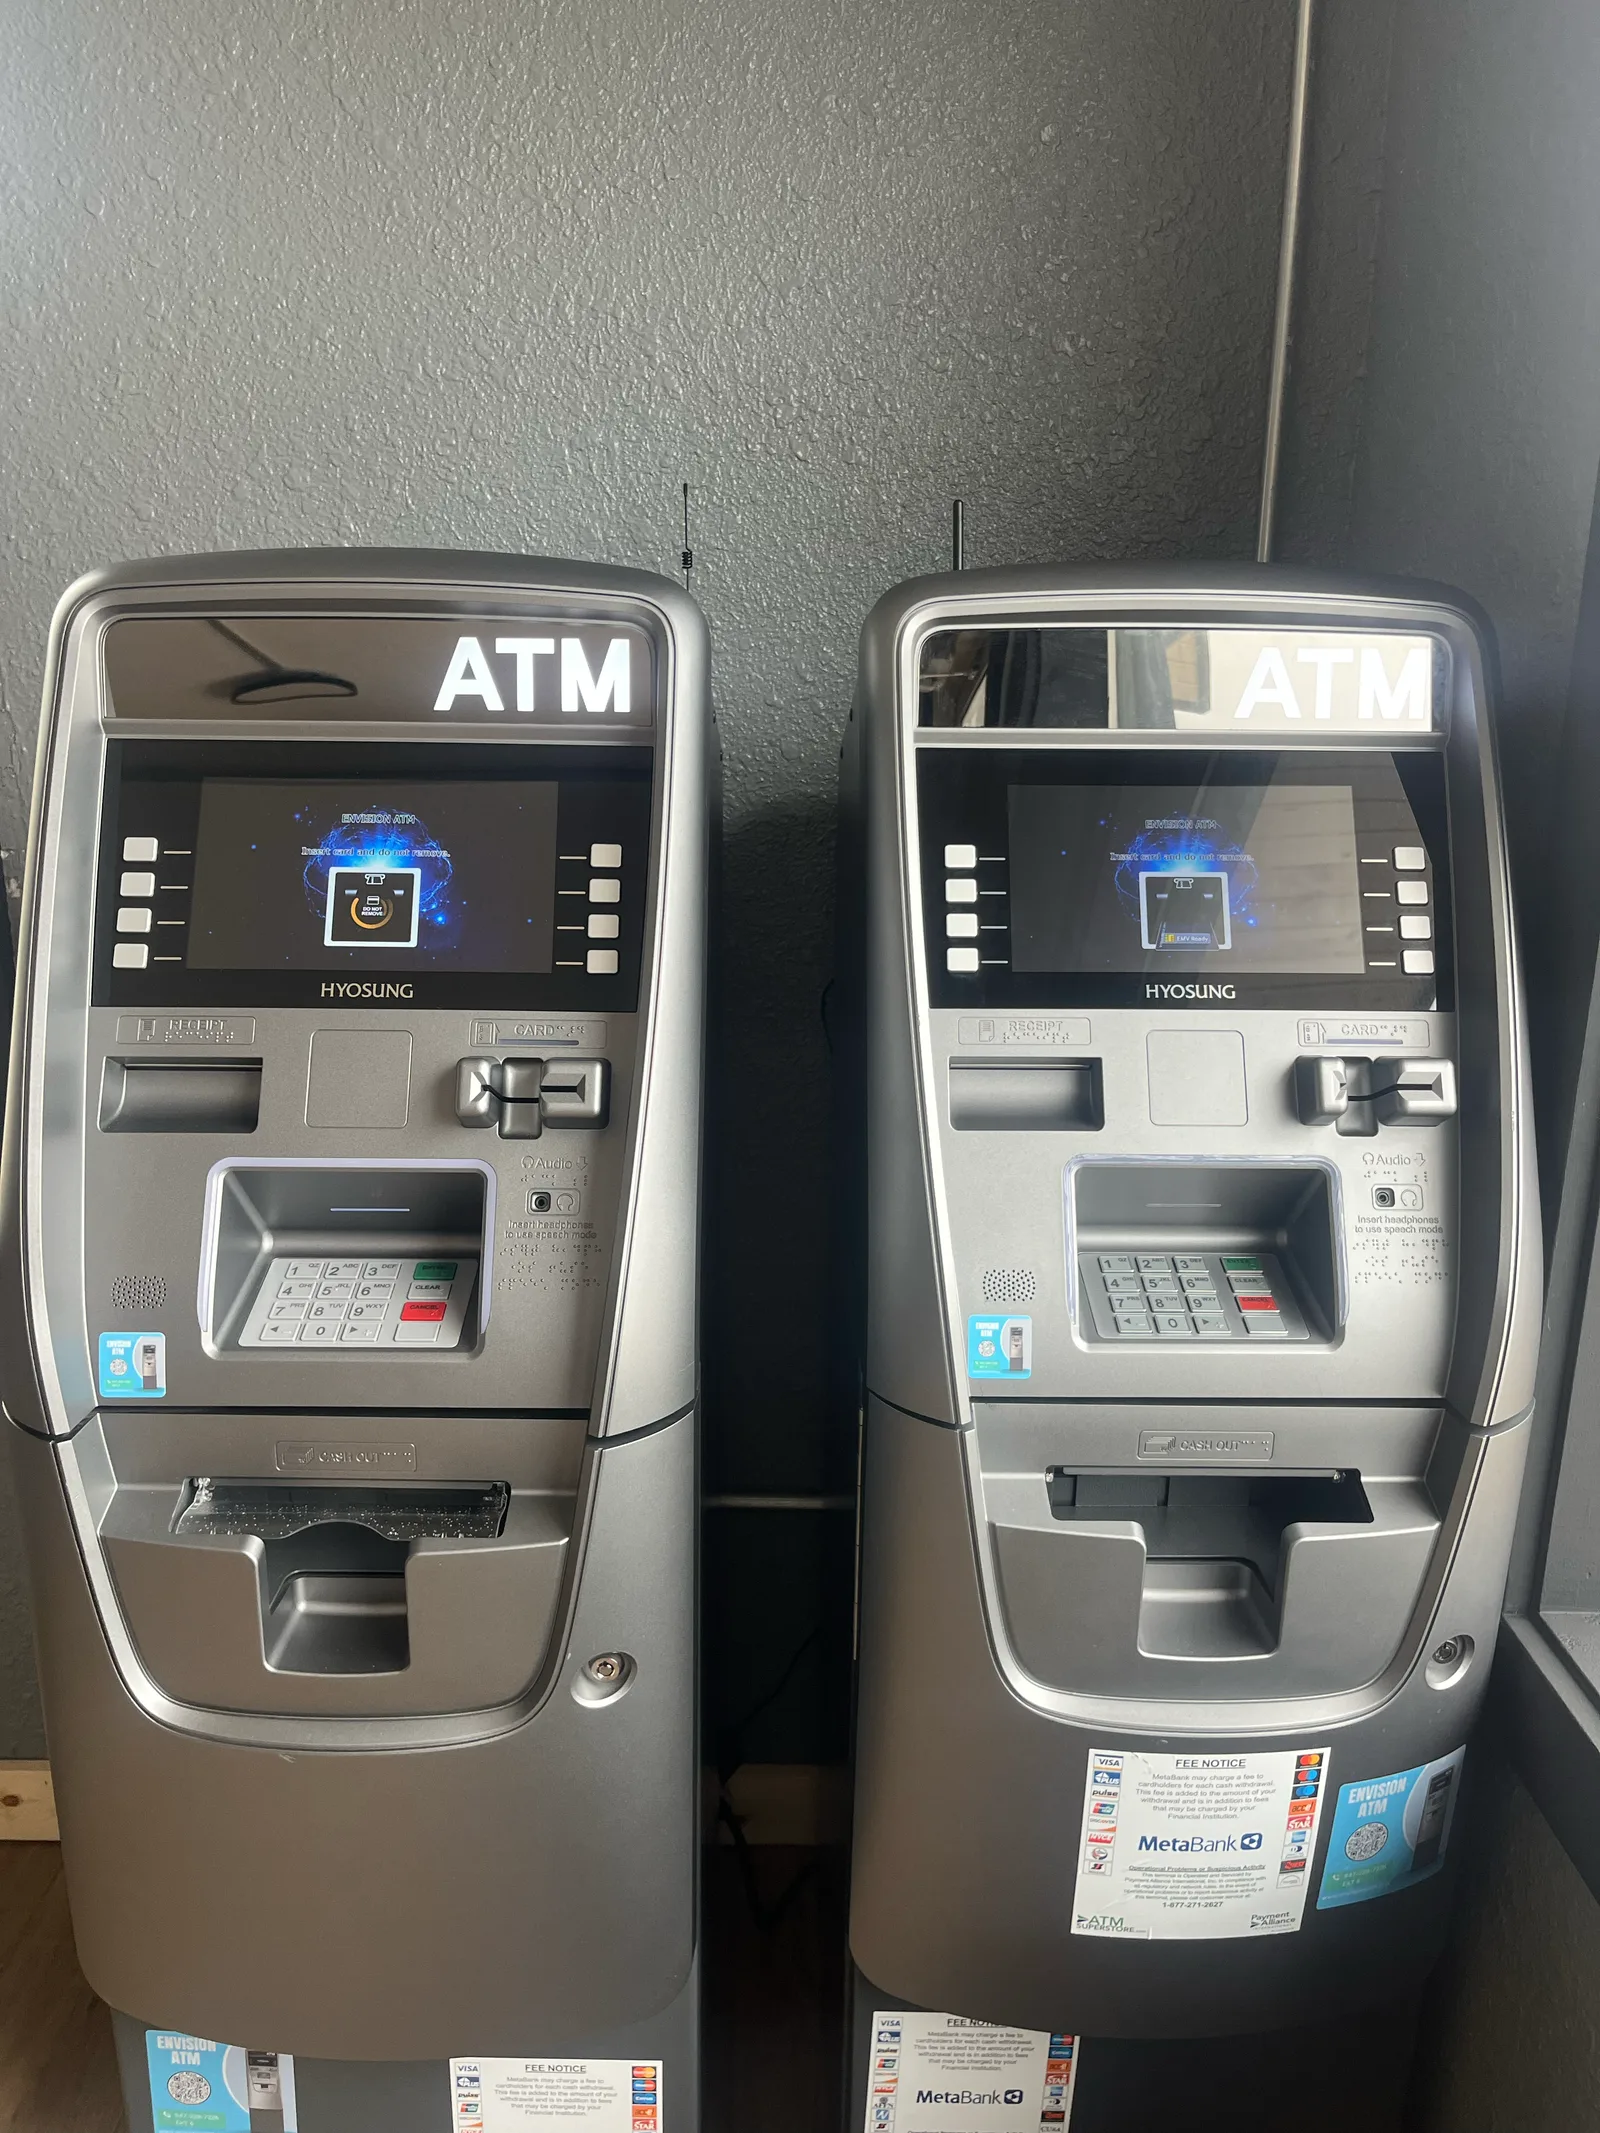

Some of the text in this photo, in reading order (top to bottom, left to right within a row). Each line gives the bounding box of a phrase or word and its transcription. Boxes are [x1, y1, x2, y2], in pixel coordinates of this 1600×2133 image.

[433, 636, 631, 713] ATM
[1233, 646, 1430, 720] ATM
[341, 813, 416, 824] ENVISION ATM
[1144, 819, 1217, 829] ENVISION ATM
[301, 846, 451, 858] Insert card and do not remove.
[1110, 852, 1139, 861] Insert
[1140, 852, 1161, 861] card
[1163, 853, 1181, 861] and
[1184, 853, 1196, 861] do
[1199, 853, 1215, 861] not
[320, 983, 414, 998] HYOSUNG
[1145, 984, 1236, 999] HYOSUNG
[168, 1019, 228, 1031] RECEIPT
[514, 1024, 555, 1036] CARD
[1008, 1020, 1064, 1032] RECEIPT
[1341, 1023, 1379, 1036] CARD
[535, 1157, 573, 1169] Audio
[1376, 1153, 1411, 1166] Audio
[508, 1219, 594, 1231] Insert headphones
[1357, 1215, 1440, 1225] Insert headphones
[504, 1230, 598, 1240] to use speech mode
[1354, 1225, 1444, 1235] to use speech mode
[1104, 1259, 1112, 1268] 1
[1142, 1259, 1152, 1269] 2
[1180, 1260, 1189, 1269] 3
[291, 1266, 299, 1276] 1
[328, 1266, 340, 1276] 2
[368, 1267, 378, 1276] 3
[1110, 1278, 1120, 1288] 4
[1149, 1278, 1158, 1288] 5
[1186, 1278, 1196, 1288] 6
[282, 1286, 293, 1296] 4
[321, 1286, 332, 1296] 5
[361, 1286, 371, 1296] 6
[1115, 1298, 1124, 1308] 7
[1155, 1298, 1164, 1308] 8
[1193, 1298, 1203, 1308] 9
[275, 1306, 286, 1316] 7
[314, 1306, 325, 1316] 8
[353, 1307, 364, 1317] 9
[1168, 1318, 1178, 1328] 0
[316, 1326, 326, 1336] 0
[1179, 1440, 1240, 1451] CASH OUT
[356, 1452, 379, 1462] OUT
[1098, 1758, 1120, 1766] VISA
[1175, 1758, 1247, 1768] FEE NOTICE
[1100, 1776, 1120, 1785] PLUS
[1260, 1788, 1277, 1796] your
[1348, 1777, 1407, 1804] ENVISION
[1357, 1799, 1388, 1818] ATM
[1288, 1819, 1311, 1830] STAR
[1138, 1834, 1238, 1852] MetaBank
[1251, 1911, 1290, 1920] Payment
[1089, 1915, 1124, 1927] ATM
[1260, 1917, 1296, 1926] Alliance
[1076, 1923, 1135, 1932] SUPERSTORE
[947, 2018, 967, 2026] FEE
[156, 2035, 217, 2051] ENVISION
[171, 2051, 201, 2065] ATM
[525, 2064, 587, 2073] FEE NOTICE
[916, 2089, 1002, 2105] MetaBank
[634, 2122, 655, 2130] STAR
